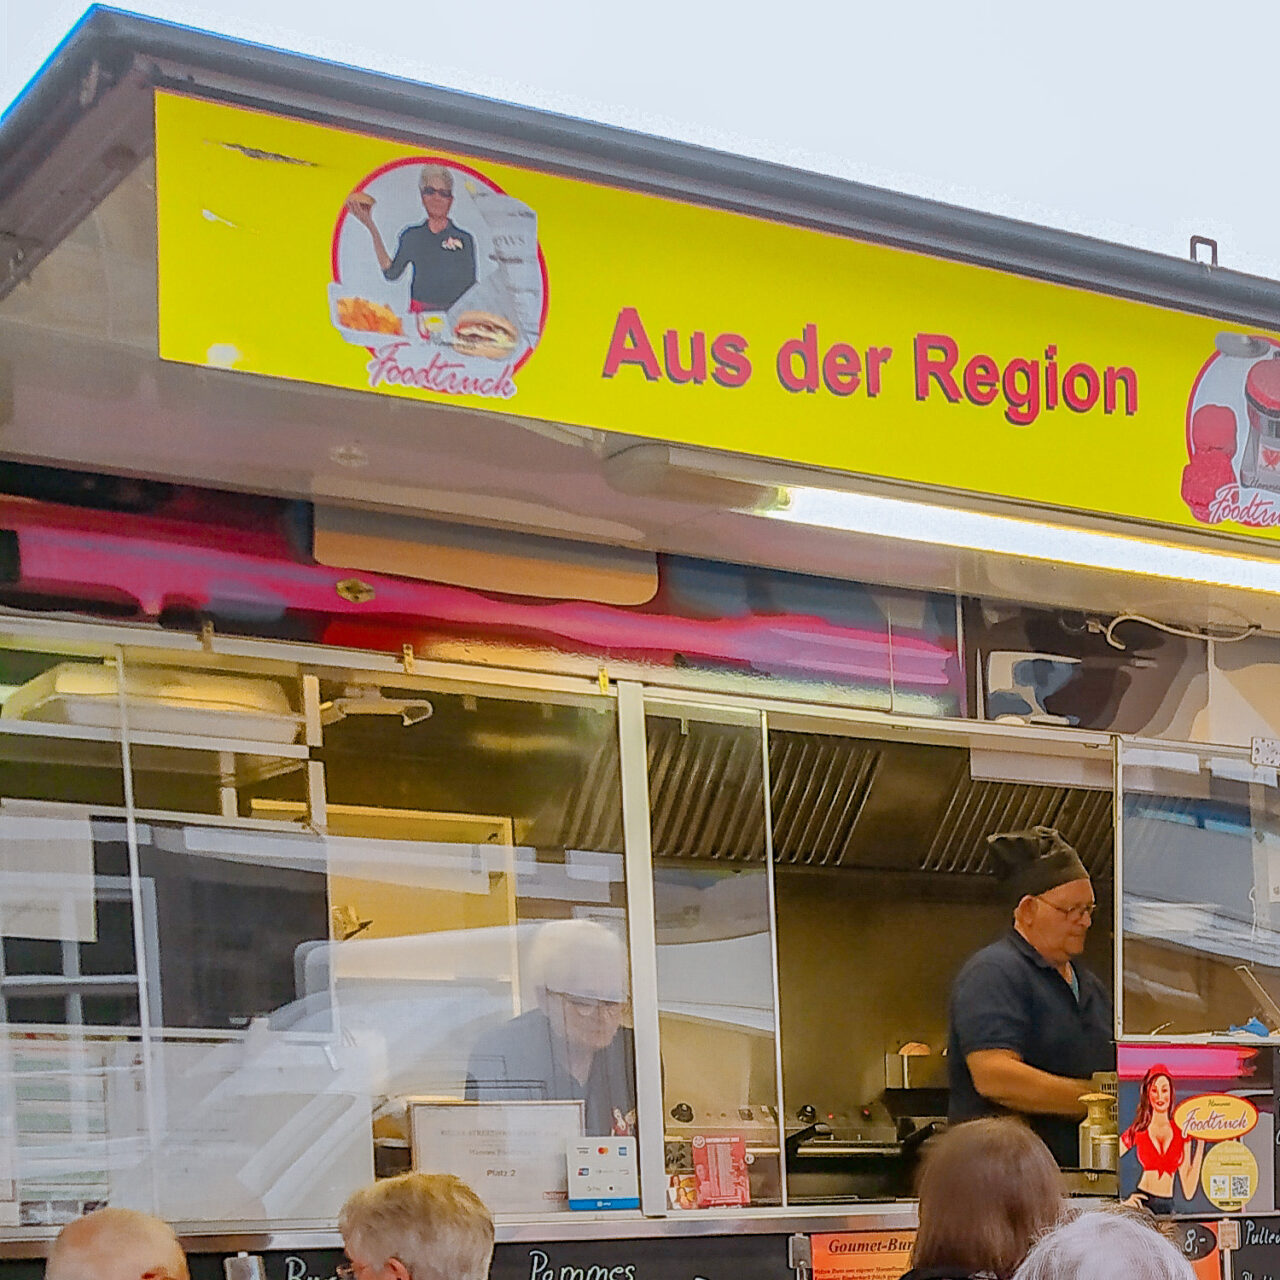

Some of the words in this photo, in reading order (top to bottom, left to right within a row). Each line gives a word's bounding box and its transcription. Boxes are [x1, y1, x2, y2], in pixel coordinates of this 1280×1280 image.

[367, 342, 516, 397] Foodtruck
[602, 306, 753, 388] Aus
[776, 323, 893, 398] der
[914, 333, 1138, 425] Region
[1182, 1106, 1248, 1138] Foodtruck
[828, 1237, 914, 1254] Goumet-Bur
